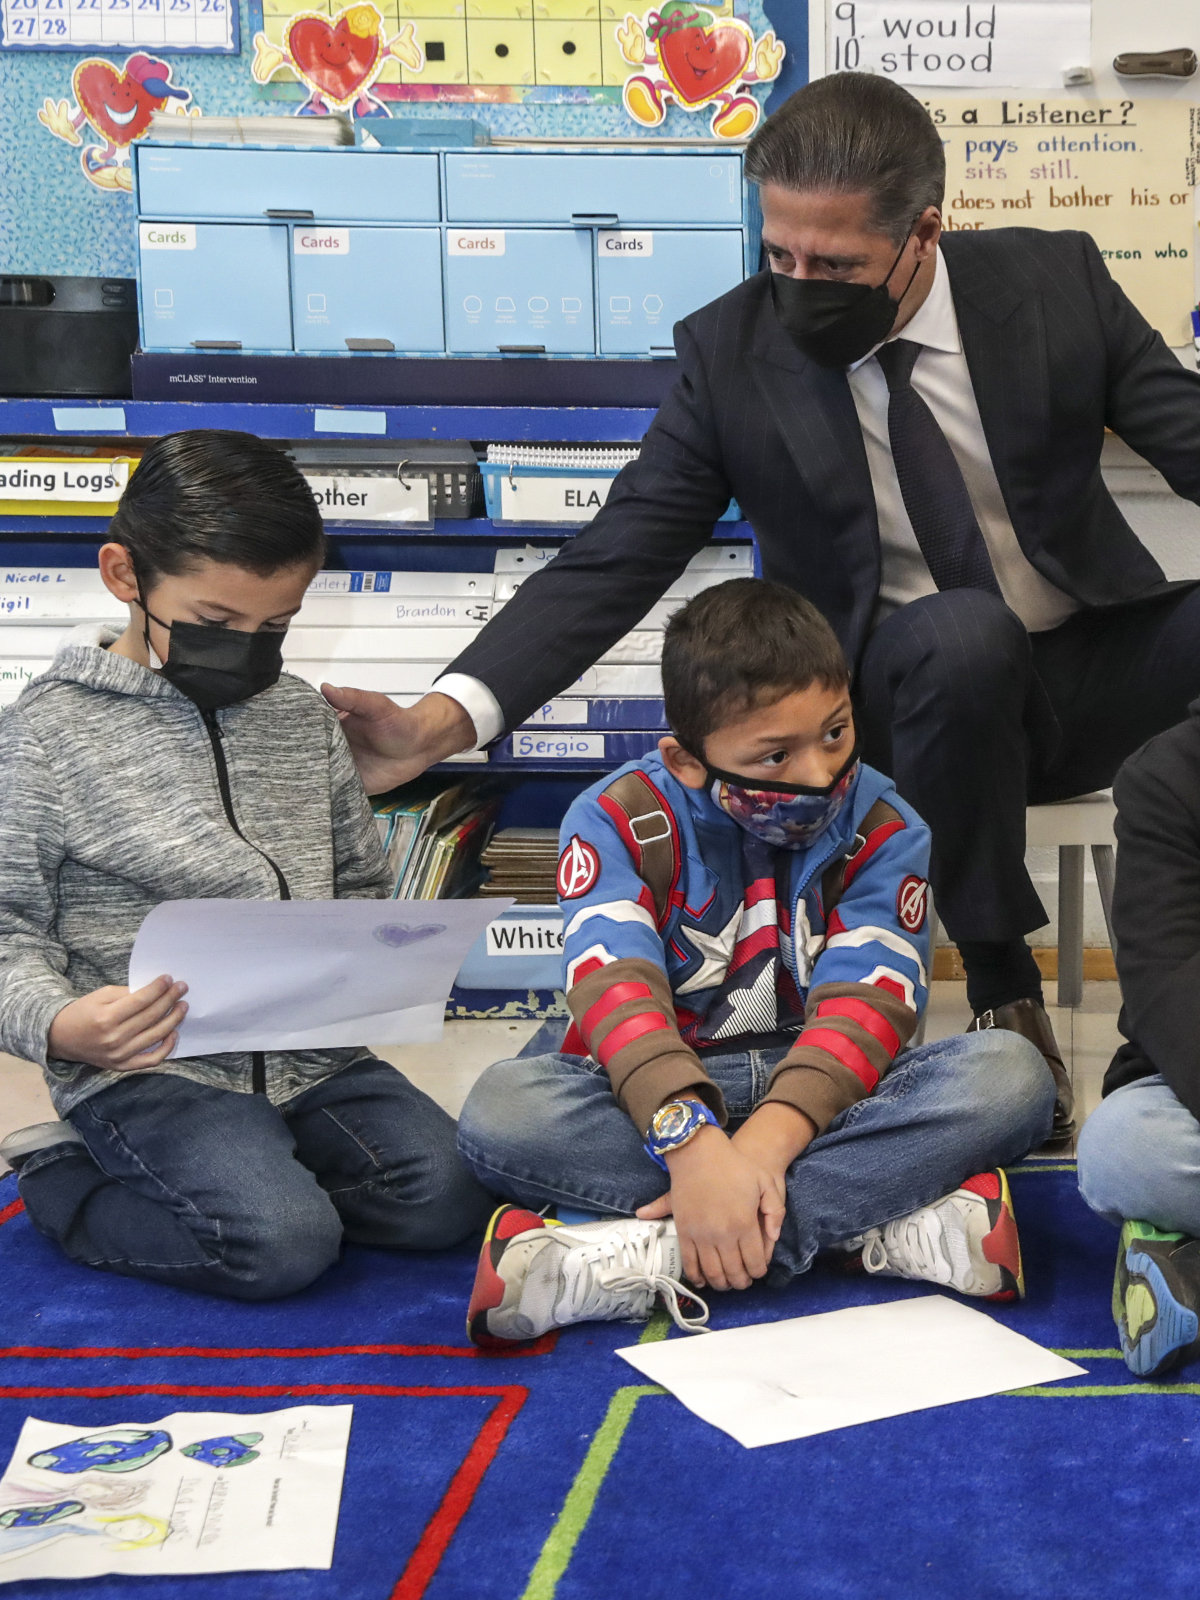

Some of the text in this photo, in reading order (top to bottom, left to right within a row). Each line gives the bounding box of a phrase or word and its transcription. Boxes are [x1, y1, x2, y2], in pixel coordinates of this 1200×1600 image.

[201, 0, 225, 12] 26
[12, 18, 67, 37] 27 28
[883, 4, 996, 39] would
[881, 41, 993, 73] stood
[961, 108, 978, 124] a
[1001, 101, 1134, 126] Listener?
[966, 134, 1144, 162] pays attention.
[965, 159, 1079, 180] sits still.
[951, 185, 1190, 209] does not bother his or
[147, 230, 187, 245] Cards
[301, 235, 340, 250] Cards
[457, 236, 496, 251] Cards
[605, 237, 644, 252] Cards
[1101, 241, 1188, 260] erson who
[208, 375, 258, 384] Intervention
[64, 471, 114, 492] Logs
[564, 490, 602, 508] ELA
[5, 573, 66, 583] Nicole L
[0, 596, 30, 613] igil
[396, 604, 456, 619] Brandon
[519, 736, 589, 757] Sergio
